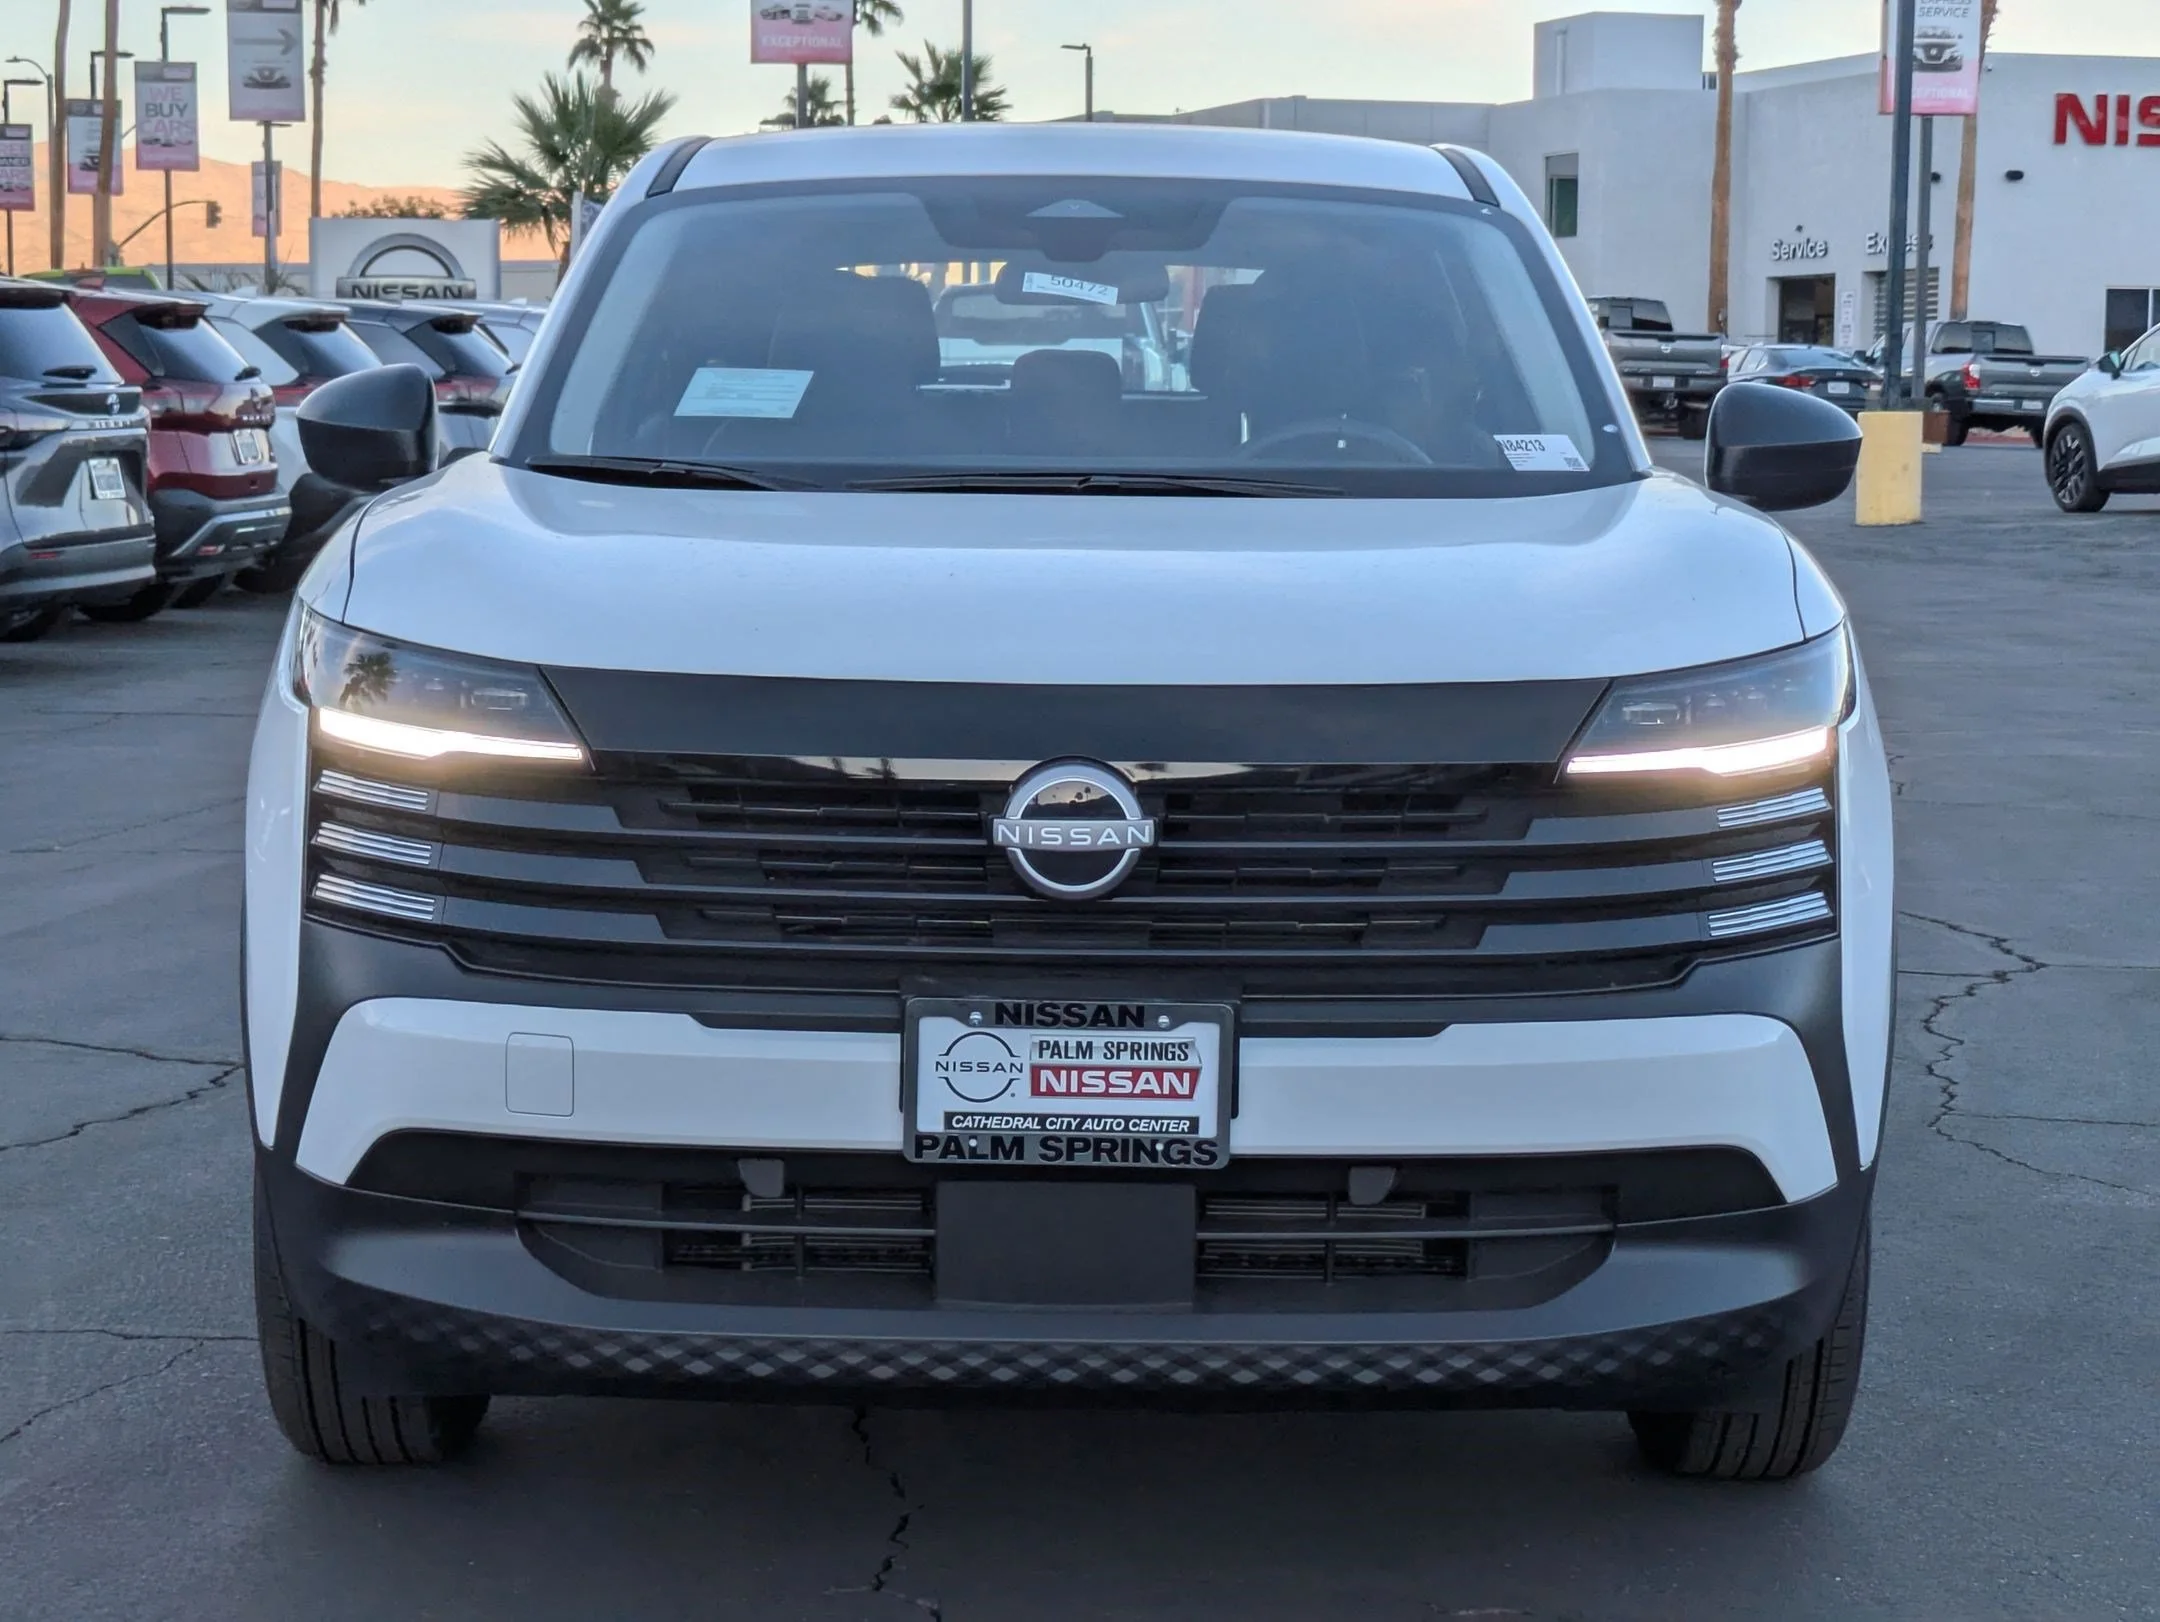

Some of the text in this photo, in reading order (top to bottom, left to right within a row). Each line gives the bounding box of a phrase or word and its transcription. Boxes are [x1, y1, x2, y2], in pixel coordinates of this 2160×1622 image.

[1918, 7, 1969, 18] SERVICE
[145, 103, 189, 118] BUY
[1771, 238, 1828, 260] Service
[351, 283, 463, 299] NISSAN
[998, 824, 1151, 846] NISSAN
[994, 1001, 1146, 1029] NISSAN
[1038, 1039, 1190, 1062] PALM SPRINGS
[935, 1060, 1024, 1074] NISSAN
[1039, 1069, 1191, 1096] NISSAN
[951, 1115, 1191, 1133] CATHEDRAL CITY AUTO CENTER
[914, 1134, 1219, 1167] PALM SPRINGS
